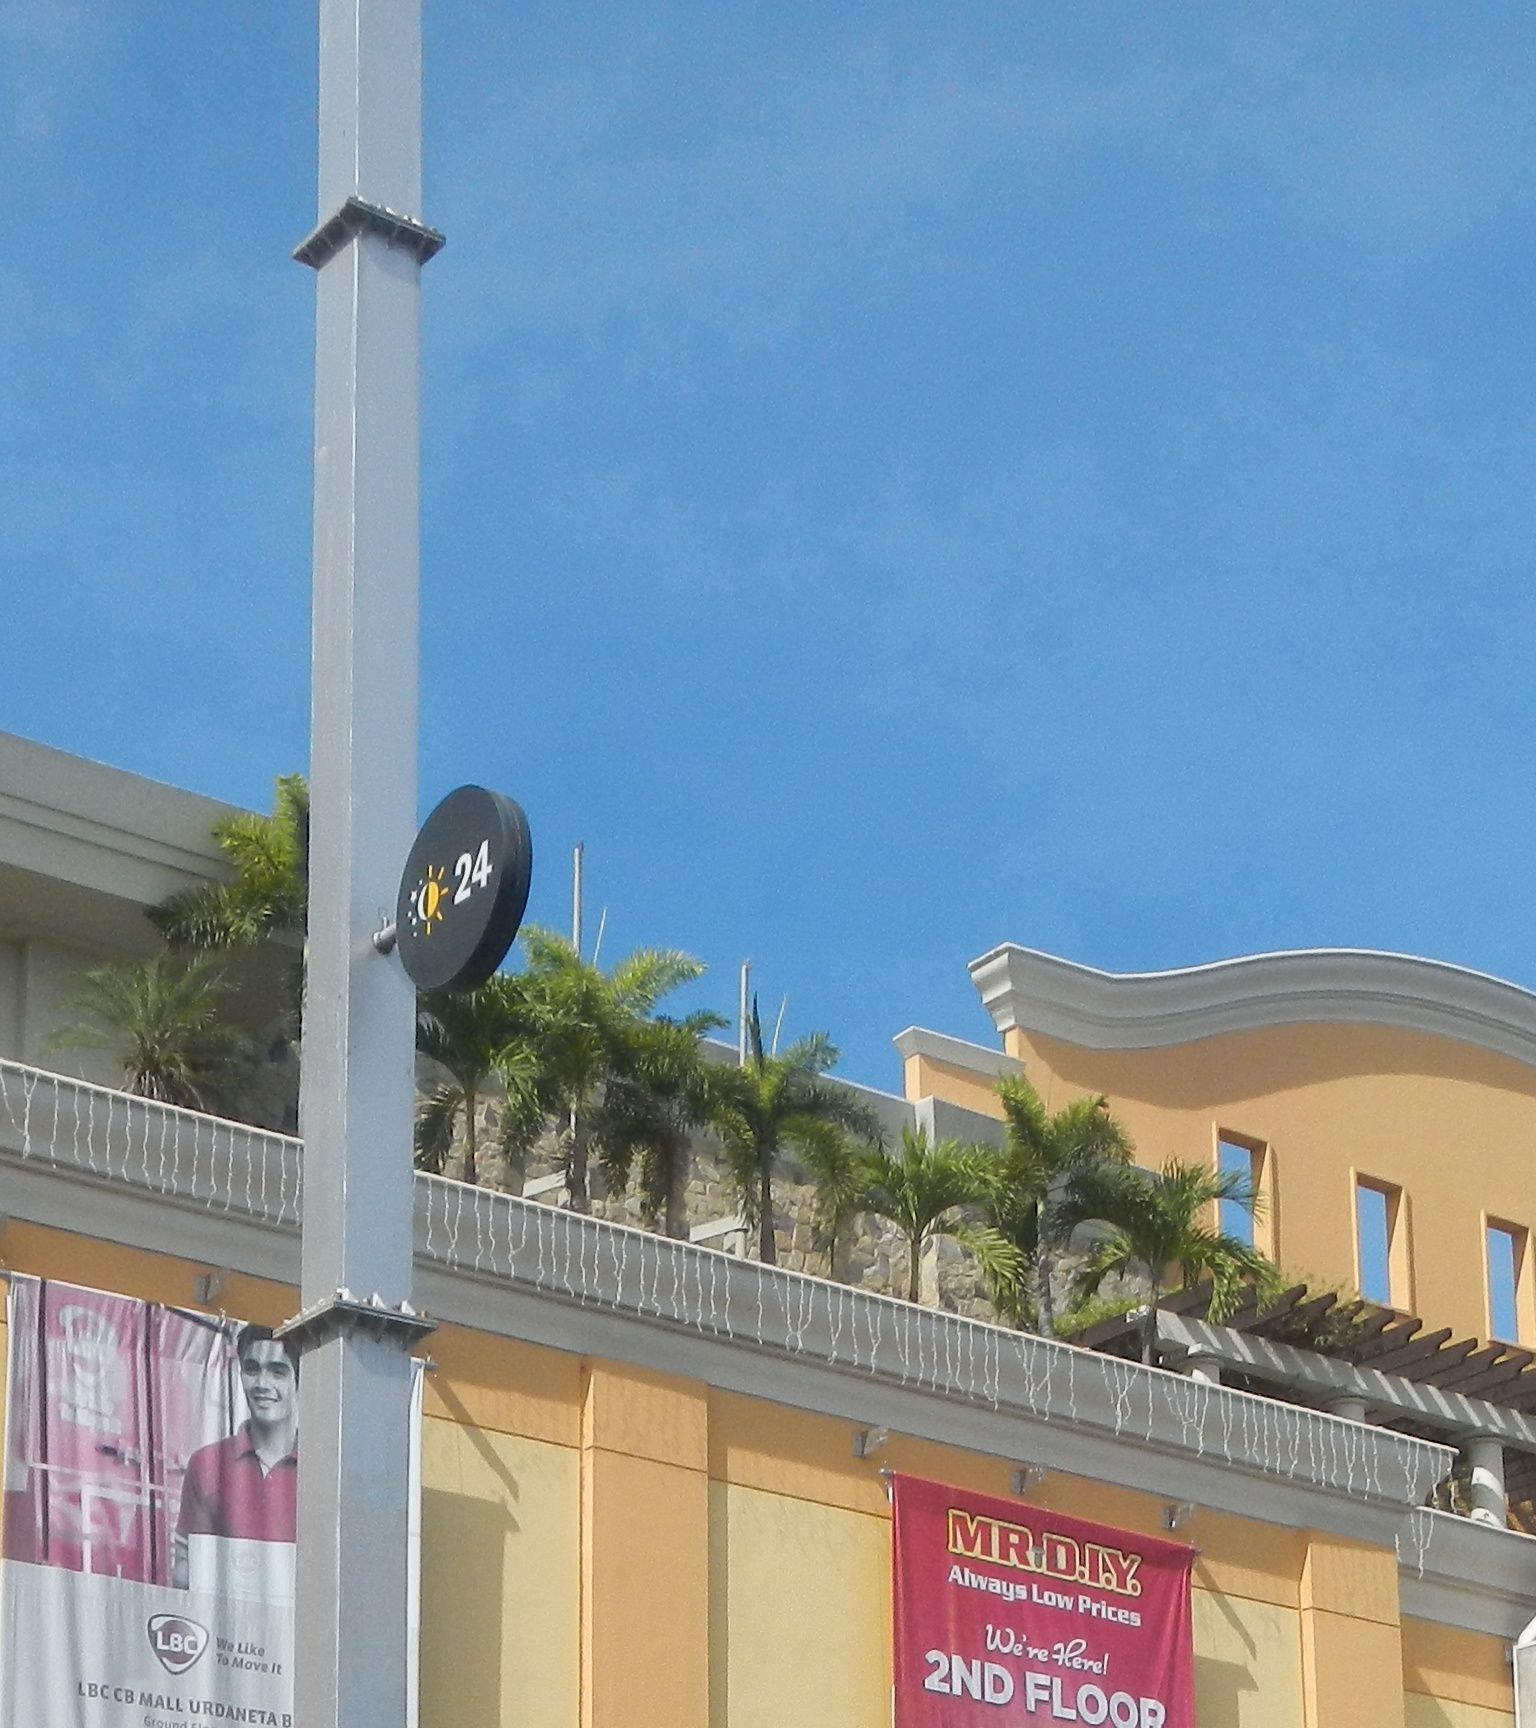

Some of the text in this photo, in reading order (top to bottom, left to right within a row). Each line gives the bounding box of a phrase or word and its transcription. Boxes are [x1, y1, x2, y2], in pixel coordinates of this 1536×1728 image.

[454, 840, 493, 905] 24
[948, 1565, 1141, 1627] Always Low Prices
[157, 1630, 198, 1654] LBC
[216, 1637, 265, 1657] We Like
[985, 1624, 1048, 1662] We're
[216, 1653, 282, 1675] To Move It
[924, 1650, 1013, 1704] 2ND
[78, 1682, 109, 1699] LBC
[114, 1687, 134, 1703] CB
[139, 1692, 183, 1713] MALL
[189, 1701, 277, 1726] URDANETA
